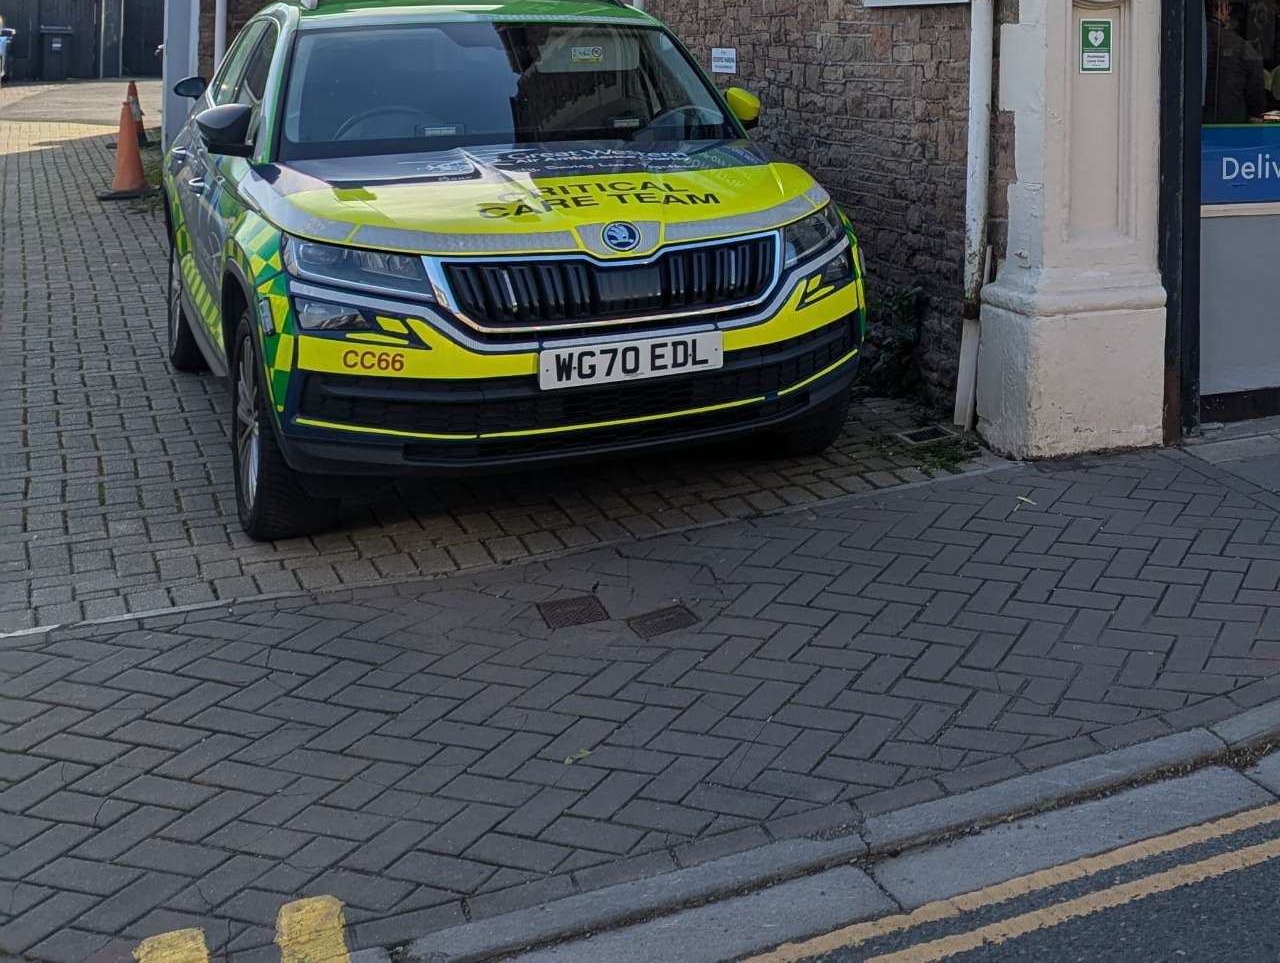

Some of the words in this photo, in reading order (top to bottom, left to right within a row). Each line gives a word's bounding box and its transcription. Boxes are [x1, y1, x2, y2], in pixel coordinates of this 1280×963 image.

[507, 149, 581, 160] Great
[479, 195, 600, 219] CARE
[606, 192, 721, 205] TEAM
[342, 349, 405, 372] CC66
[555, 345, 641, 383] WG70
[649, 339, 710, 371] EDL
